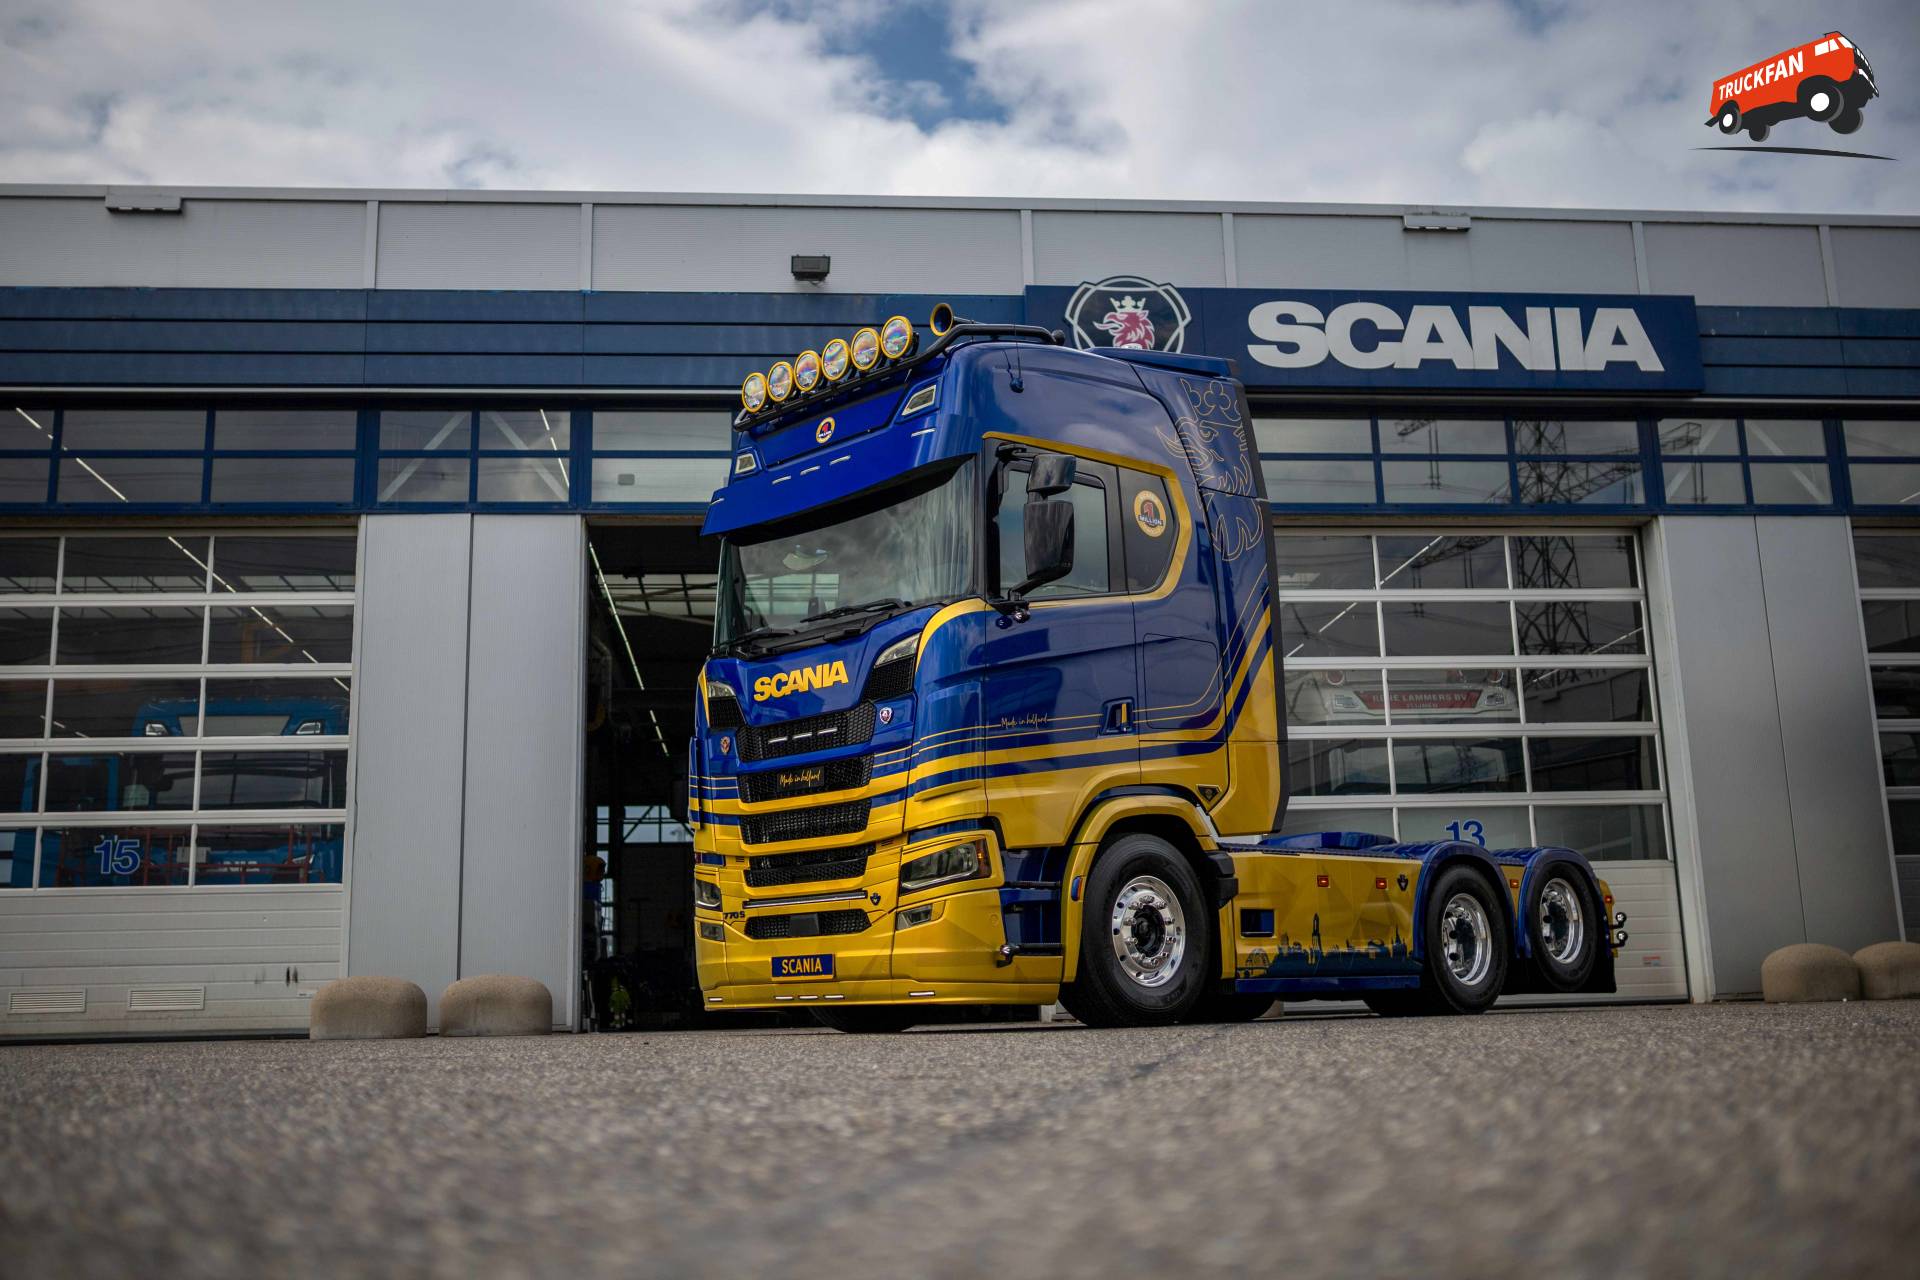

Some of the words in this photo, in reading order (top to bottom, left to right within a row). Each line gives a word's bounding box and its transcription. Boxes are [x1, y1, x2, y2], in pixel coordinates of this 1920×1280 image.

[1247, 301, 1666, 372] SCANIA
[753, 660, 849, 702] SCANIA
[1445, 820, 1486, 848] 13
[94, 839, 141, 875] 15
[782, 958, 822, 974] SCANIA
